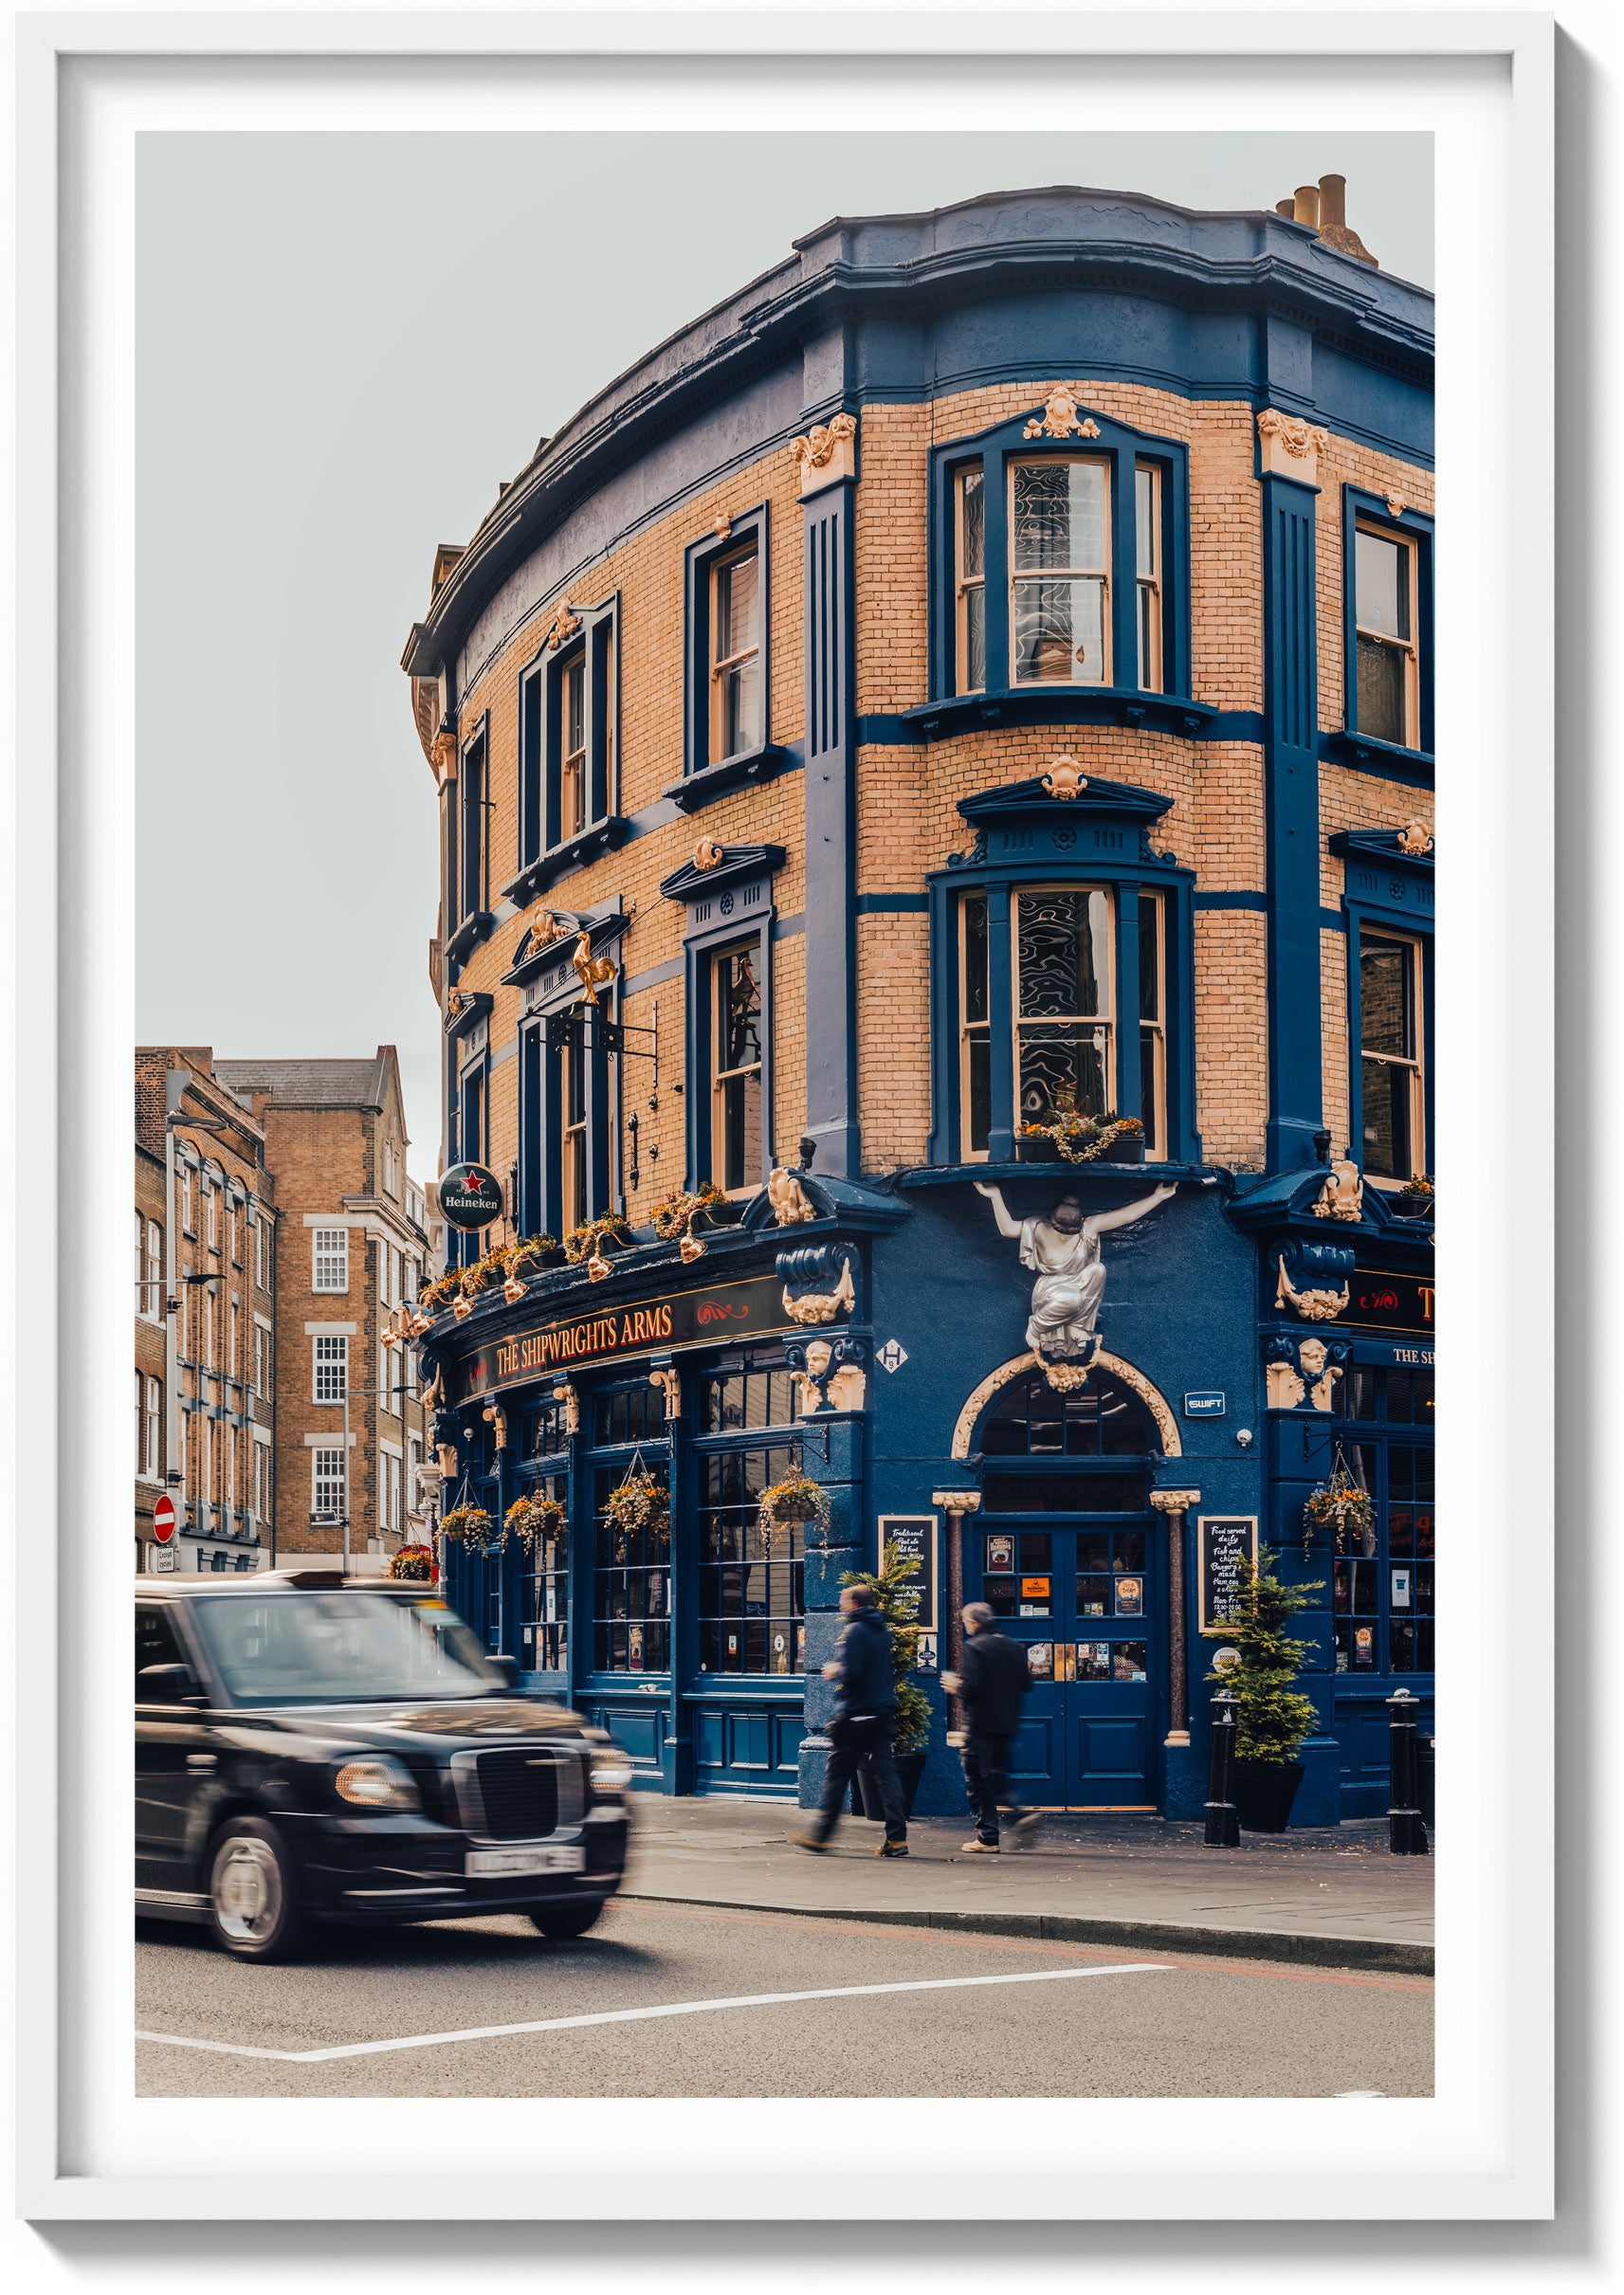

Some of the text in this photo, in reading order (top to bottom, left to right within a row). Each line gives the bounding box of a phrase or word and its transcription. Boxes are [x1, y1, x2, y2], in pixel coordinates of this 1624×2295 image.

[446, 1196, 498, 1210] Heineken
[497, 1304, 673, 1376] THE SHIPWRIGHTS ARMS
[884, 1346, 901, 1365] H
[1393, 1348, 1418, 1363] THE
[1189, 1399, 1222, 1409] SWIFT
[1211, 1525, 1247, 1535] Food served
[1218, 1535, 1238, 1546] daily
[159, 1551, 172, 1559] Except
[1213, 1545, 1242, 1556] Fish and
[159, 1560, 172, 1569] cycles
[1219, 1555, 1239, 1564] chips
